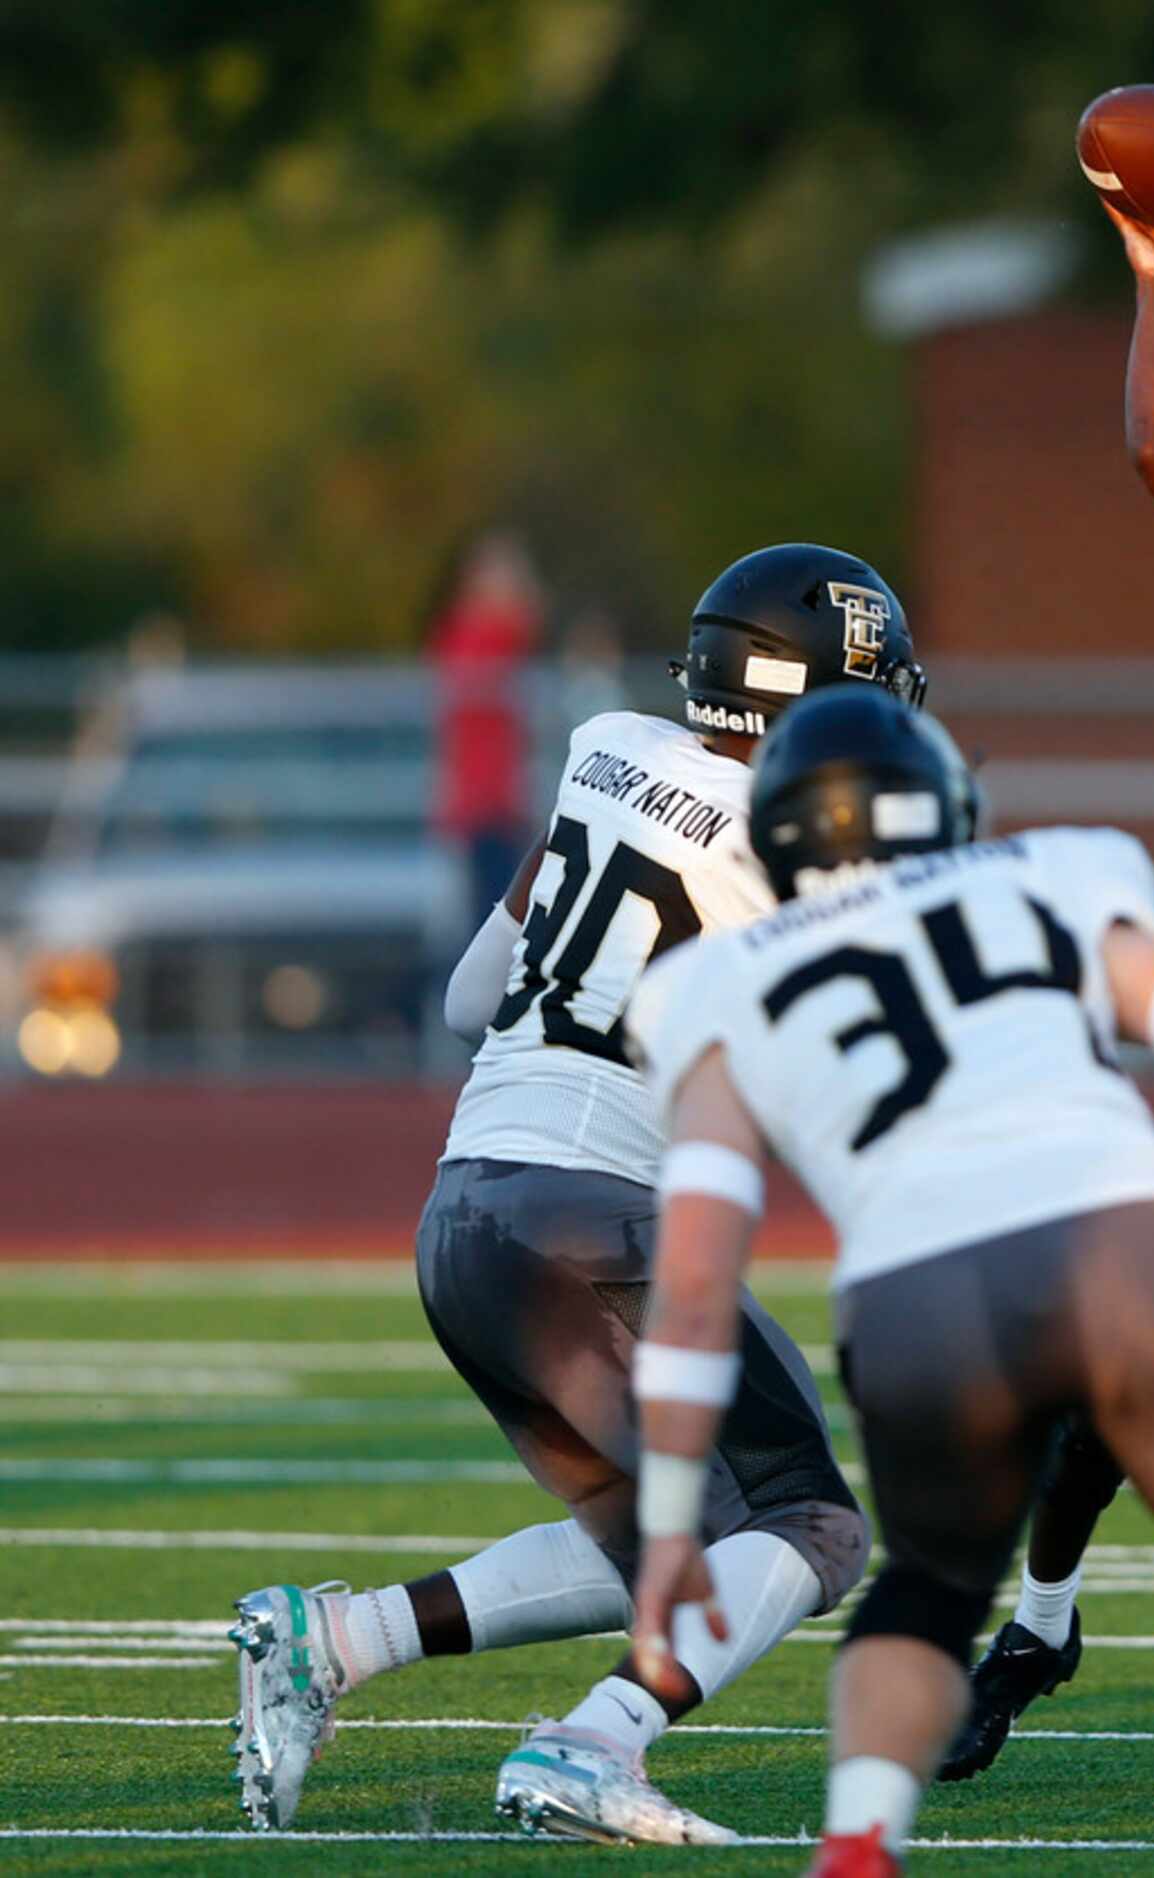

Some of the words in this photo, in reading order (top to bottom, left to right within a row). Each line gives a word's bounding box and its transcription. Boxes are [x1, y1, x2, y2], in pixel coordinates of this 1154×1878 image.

[572, 750, 649, 801] COUGAR
[631, 779, 732, 848] NATION
[760, 886, 1085, 1153] 34
